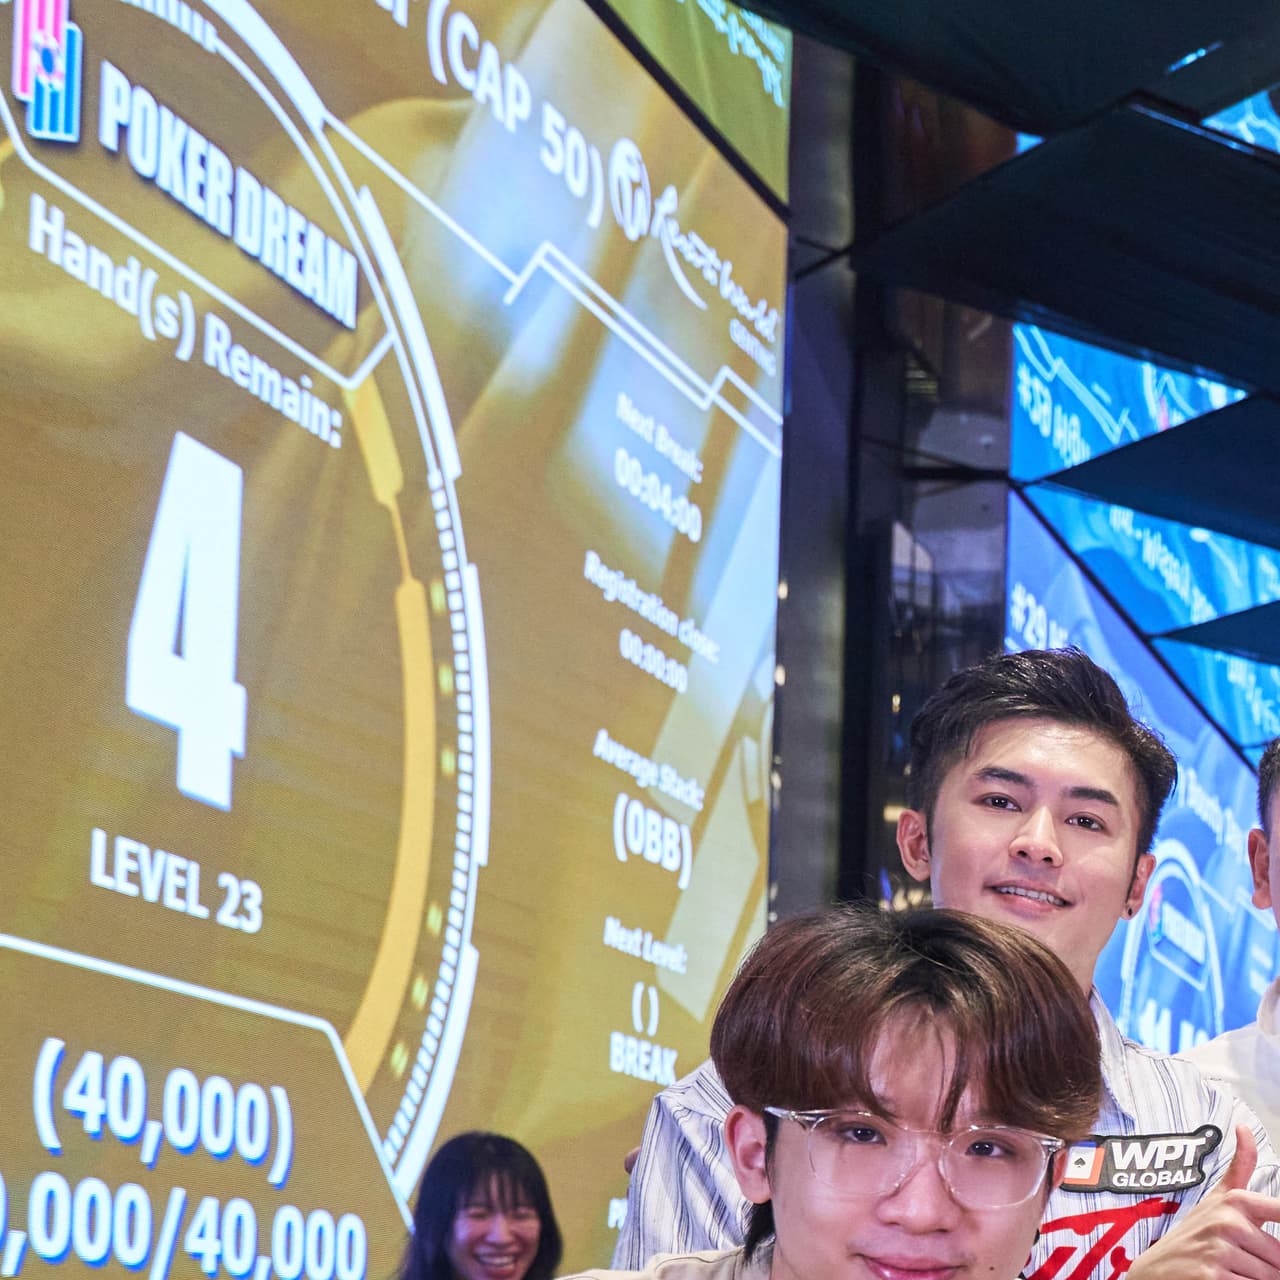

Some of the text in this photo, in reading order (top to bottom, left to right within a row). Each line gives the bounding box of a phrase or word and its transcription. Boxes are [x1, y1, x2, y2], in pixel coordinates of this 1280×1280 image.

[99, 60, 358, 331] POKER DREAM
[539, 101, 605, 229] 50)
[29, 192, 342, 449] Hand(s) Remain:
[127, 431, 247, 812] 4
[91, 828, 265, 934] LEVEL 23
[33, 1037, 294, 1189] (40,000)
[609, 1031, 678, 1087] BREAK
[1111, 1136, 1206, 1170] WPT
[1112, 1168, 1198, 1188] GLOBAL
